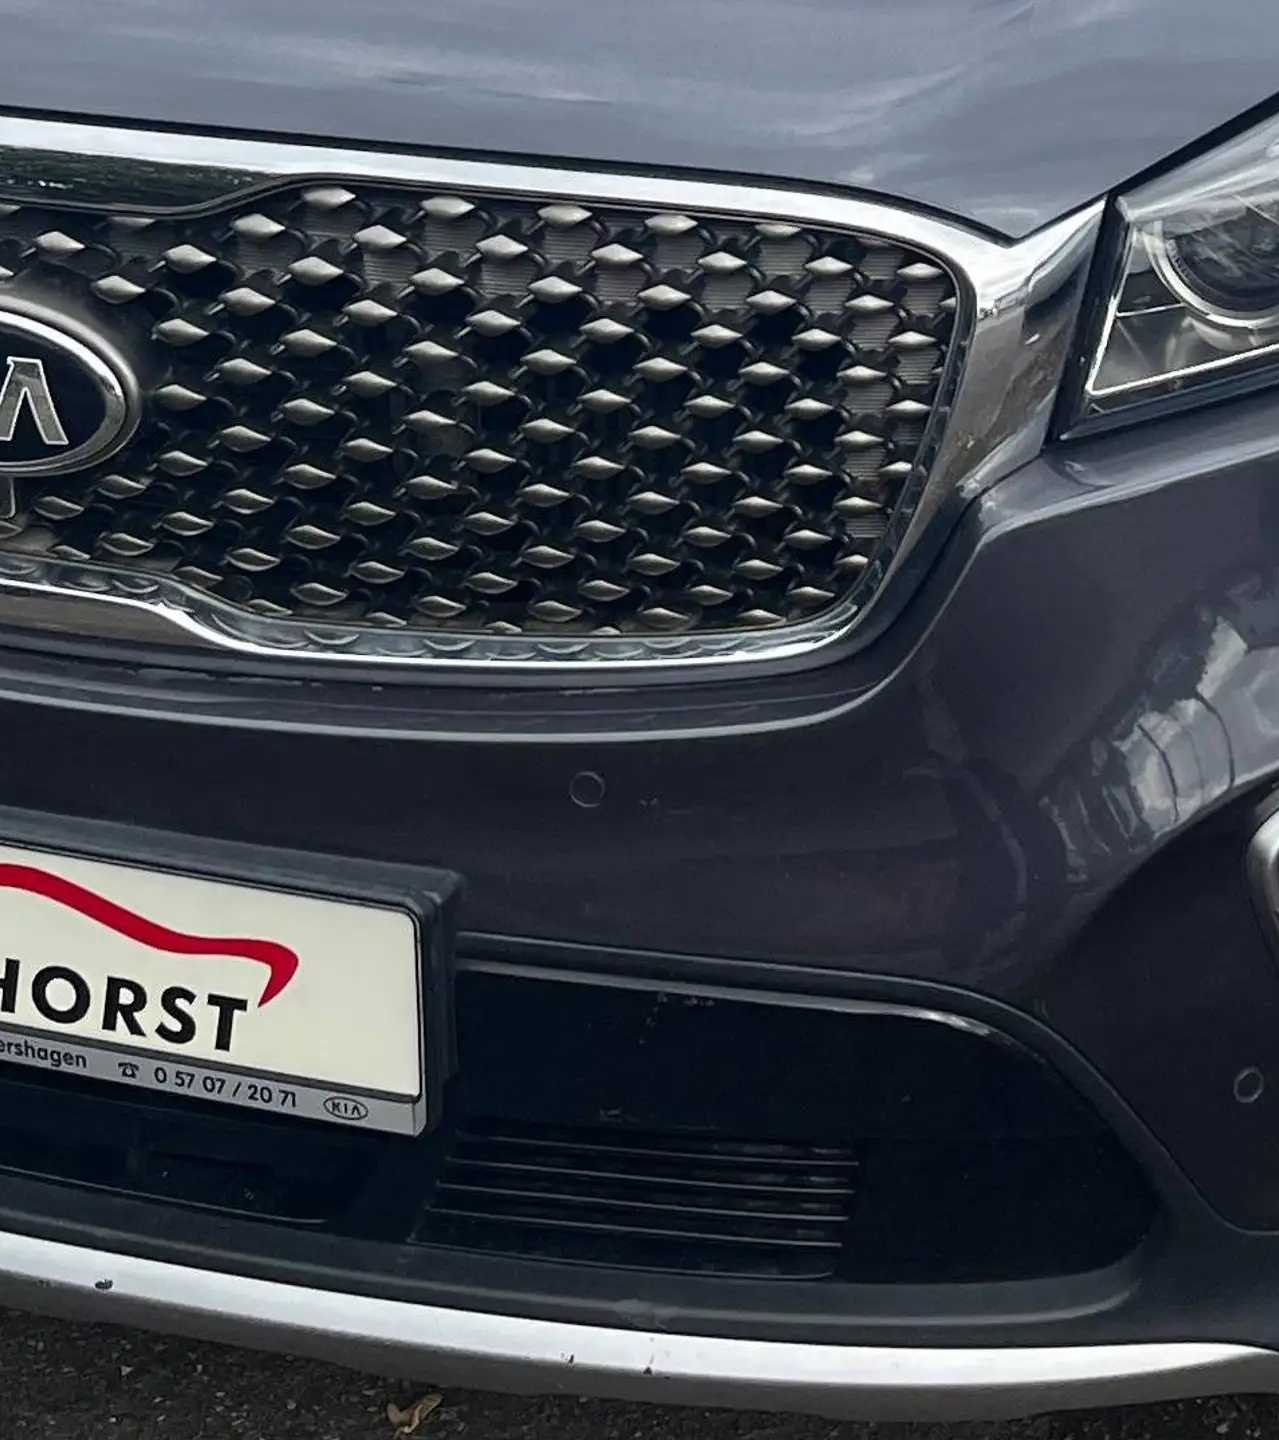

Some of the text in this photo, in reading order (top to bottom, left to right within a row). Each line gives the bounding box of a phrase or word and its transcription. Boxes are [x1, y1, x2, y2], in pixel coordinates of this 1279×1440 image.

[175, 1069, 196, 1090] 57
[203, 1075, 226, 1096] 07
[247, 1084, 273, 1104] 20
[279, 1089, 298, 1108] 71
[332, 1100, 362, 1117] KIA
